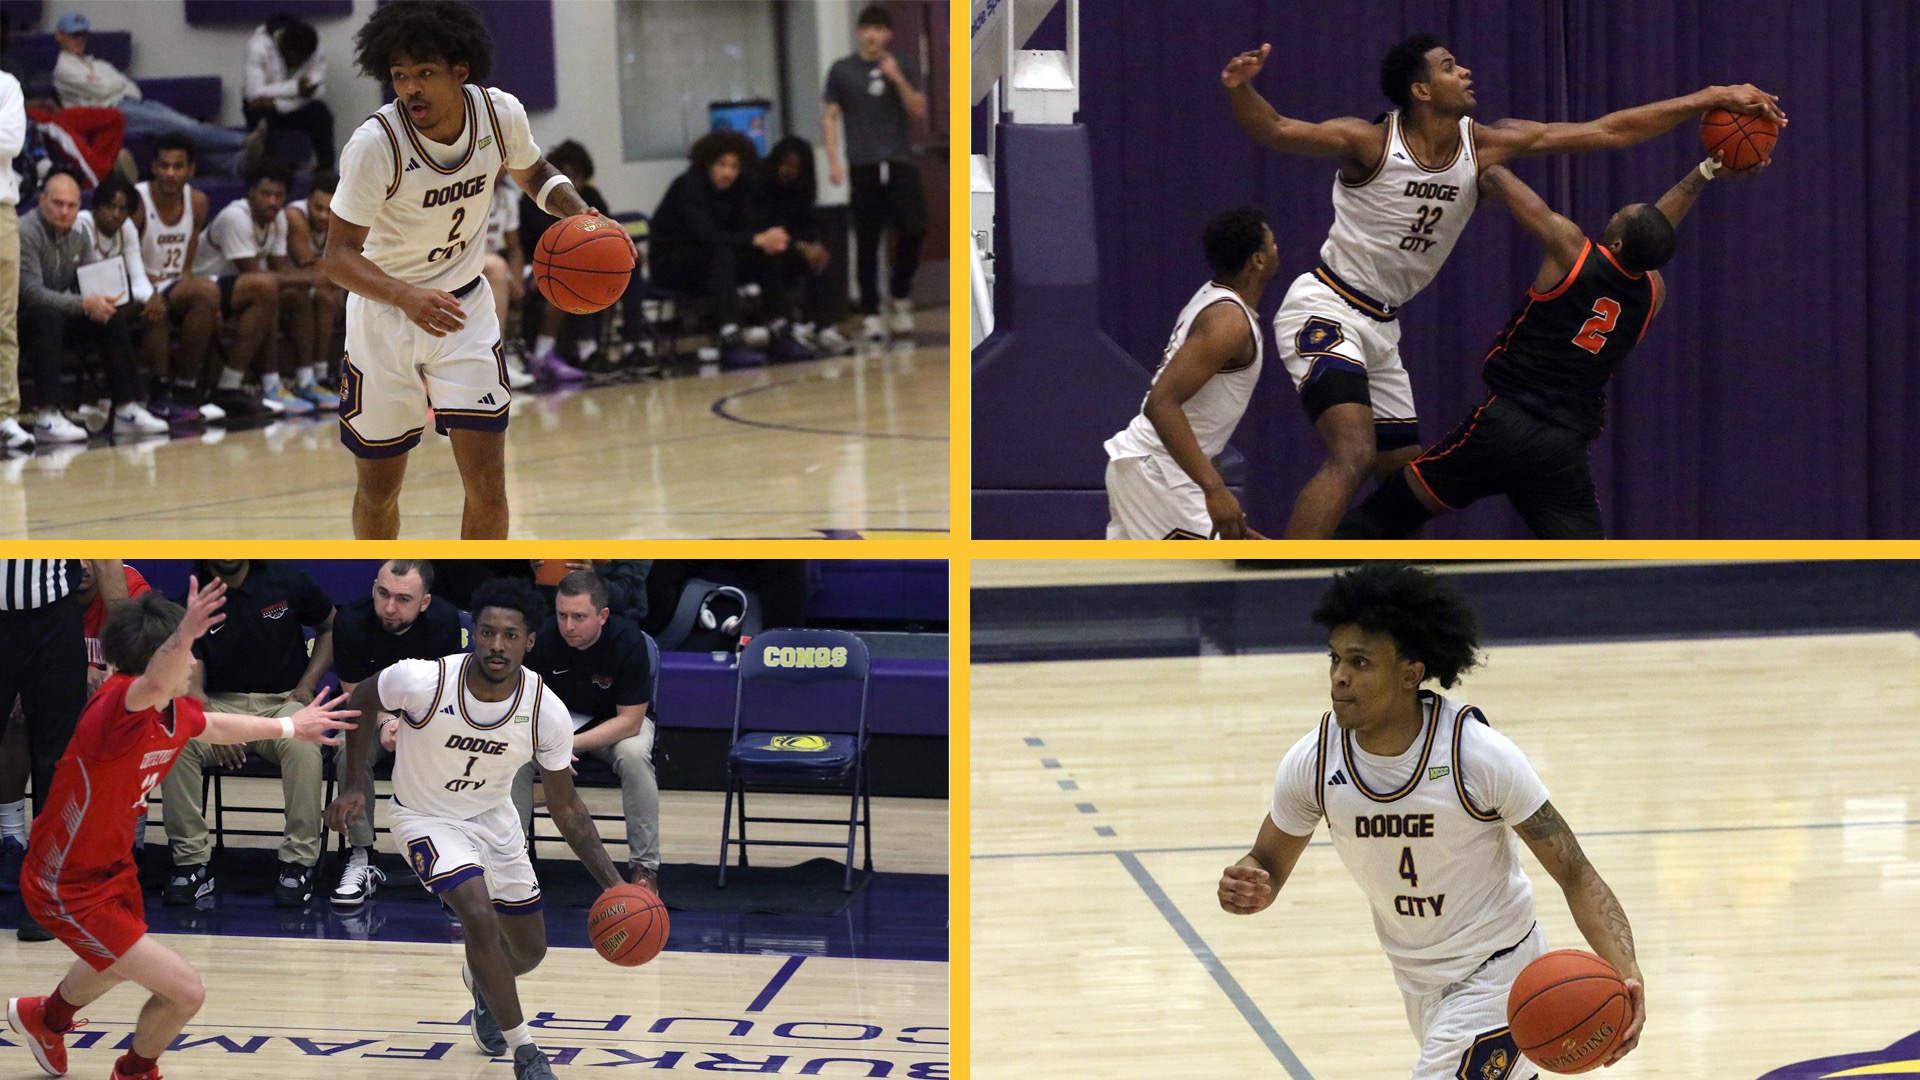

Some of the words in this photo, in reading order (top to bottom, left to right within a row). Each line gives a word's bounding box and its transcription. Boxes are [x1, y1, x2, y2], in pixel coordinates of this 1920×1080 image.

[422, 173, 487, 208] DODGE
[1403, 181, 1460, 202] DODGE
[447, 206, 466, 243] 2
[1411, 204, 1443, 235] 32
[1399, 236, 1437, 253] CITY
[1571, 296, 1622, 355] 2
[763, 646, 848, 668] CONQS
[444, 734, 509, 756] DODGE
[463, 755, 479, 778] 1
[444, 779, 487, 792] CITY
[1355, 813, 1435, 838] DODGE
[1398, 846, 1419, 888] 4
[1394, 893, 1446, 917] CITY
